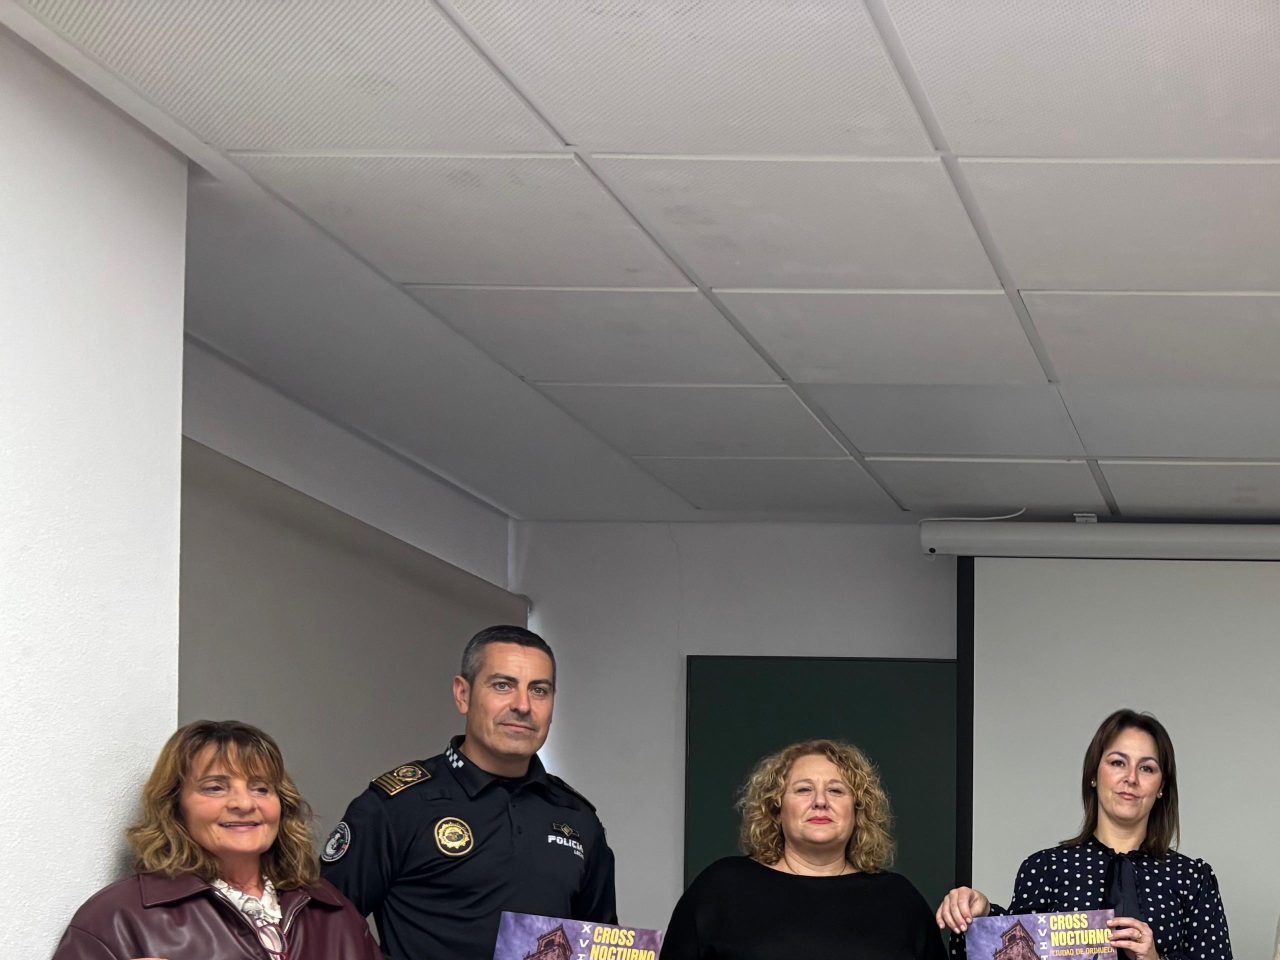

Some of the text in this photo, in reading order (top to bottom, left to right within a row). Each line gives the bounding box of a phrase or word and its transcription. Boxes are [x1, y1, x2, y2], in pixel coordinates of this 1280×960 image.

[1050, 913, 1088, 930] CROSS
[593, 926, 636, 946] CROSS
[1051, 928, 1111, 947] NOCTURNO
